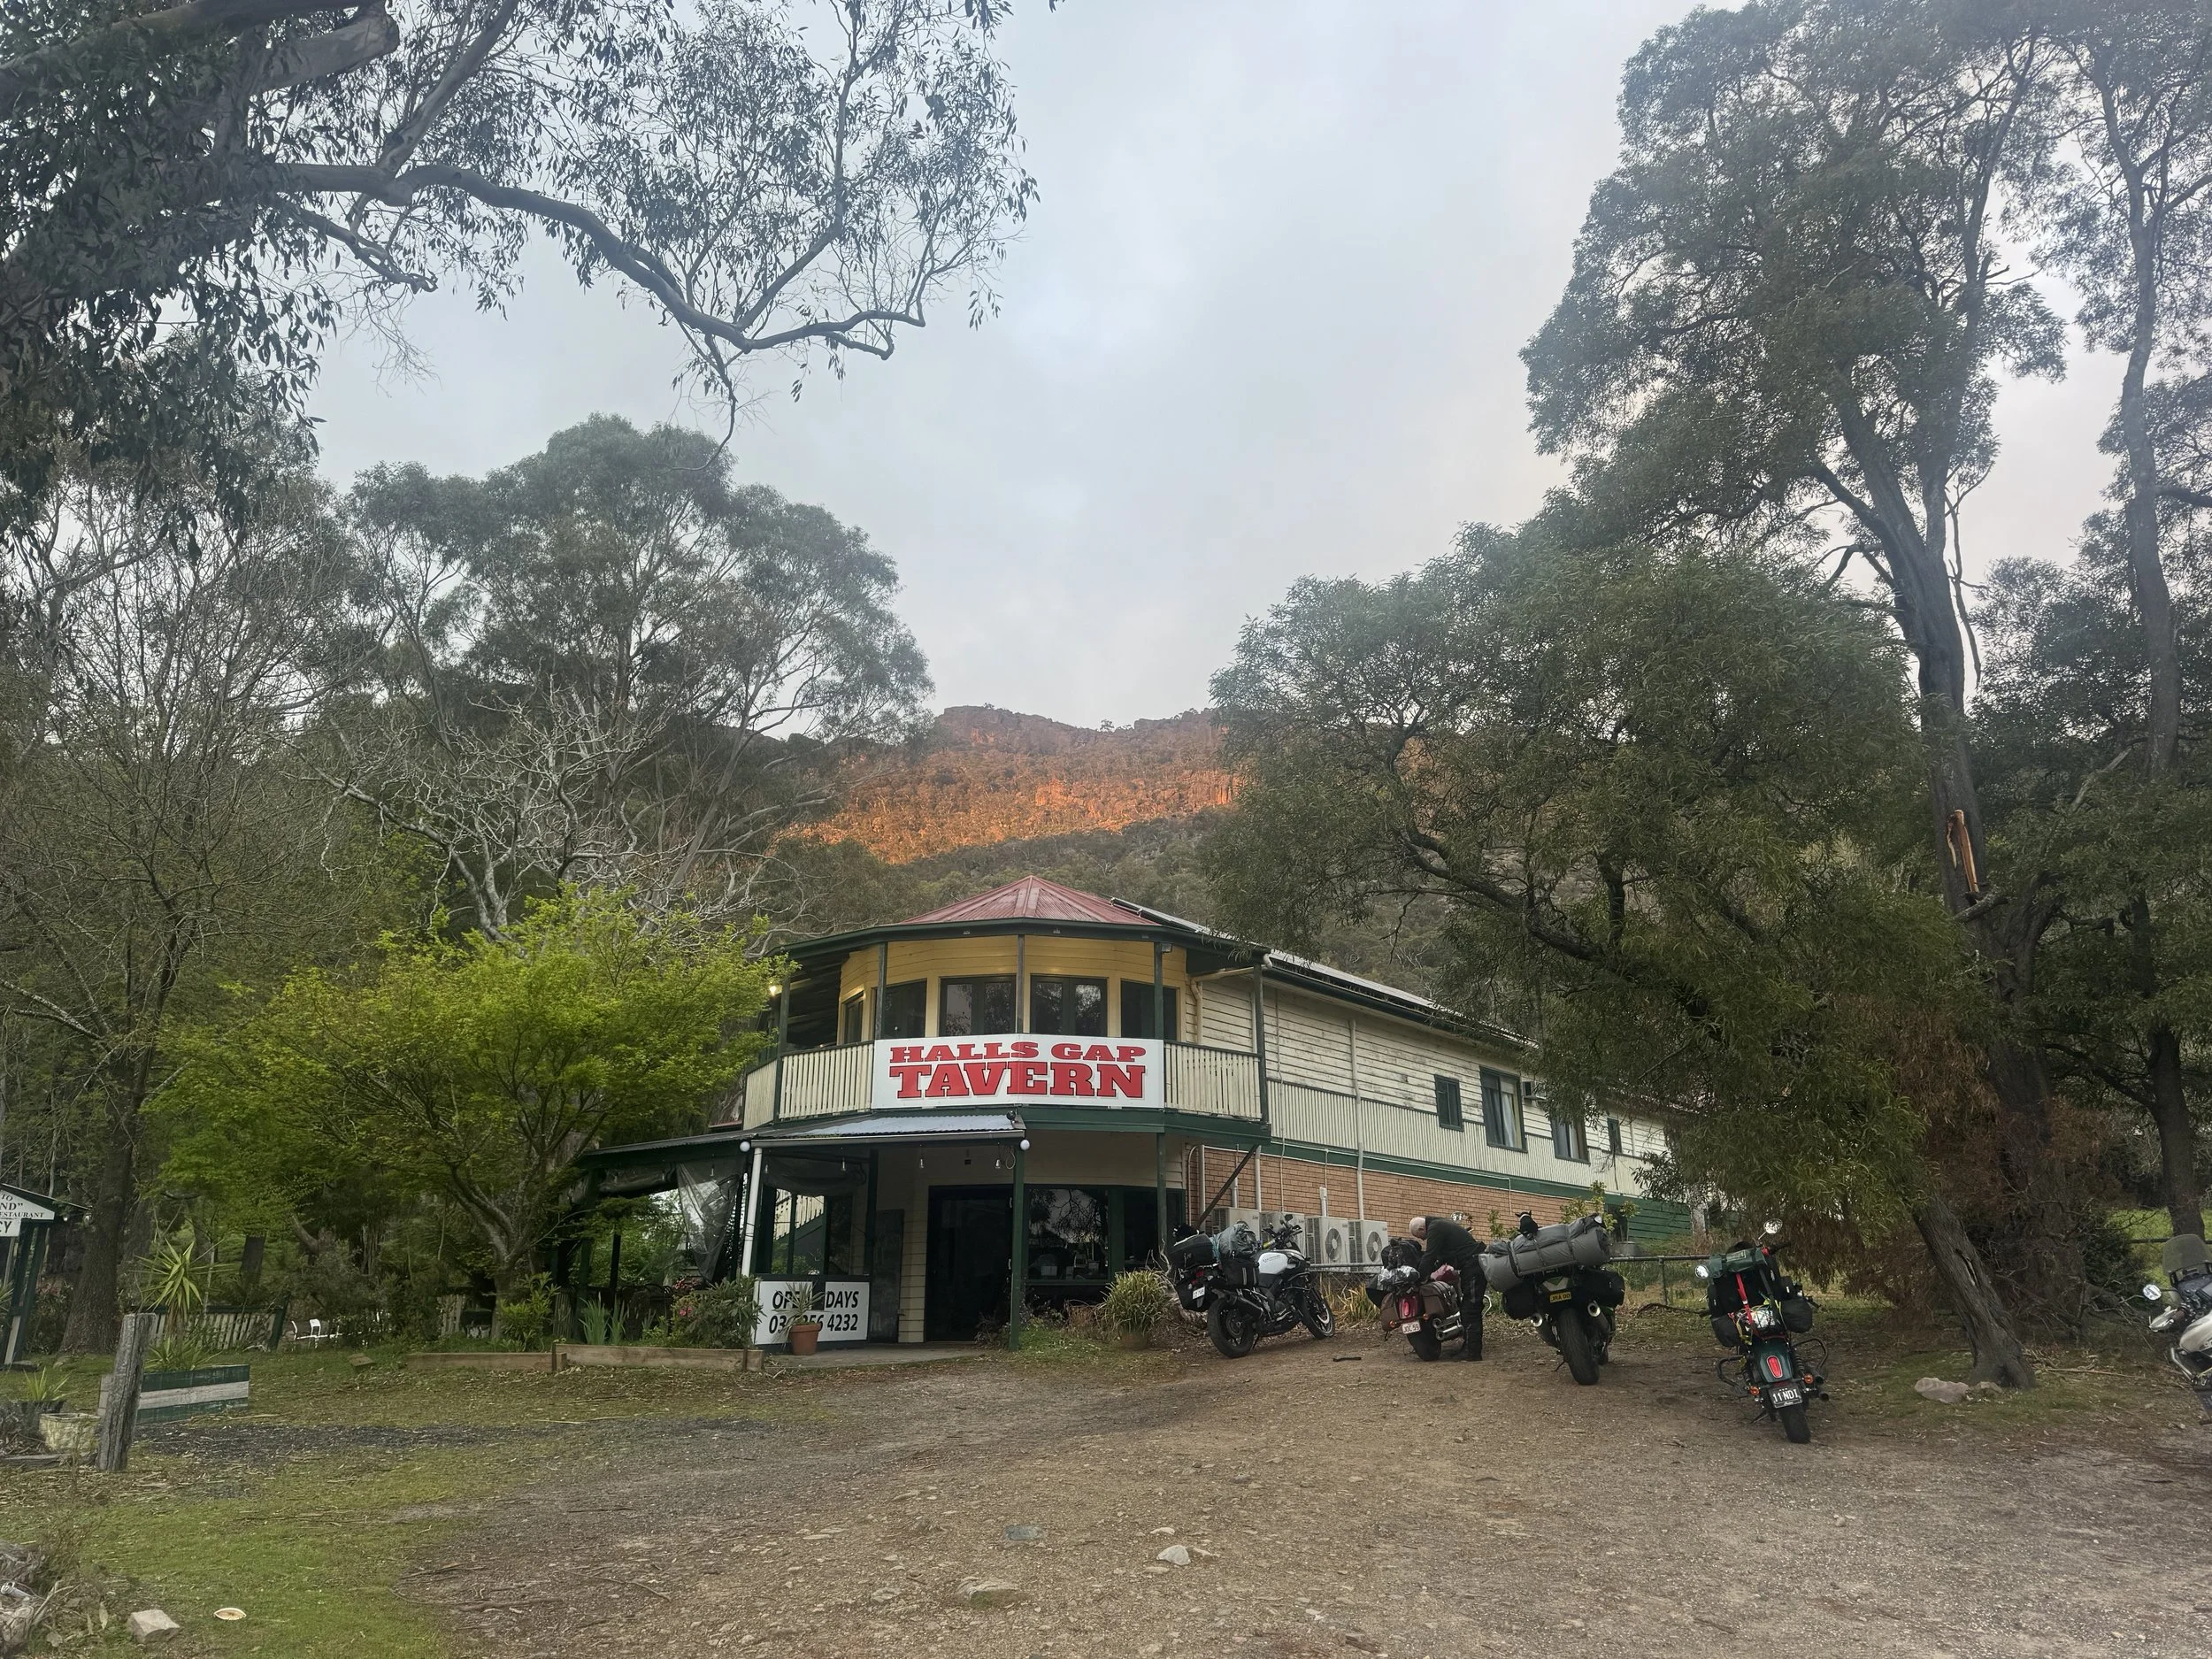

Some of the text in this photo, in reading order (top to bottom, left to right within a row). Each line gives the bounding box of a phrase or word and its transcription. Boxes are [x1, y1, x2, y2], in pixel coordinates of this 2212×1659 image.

[889, 1041, 1147, 1063] HALLS GAP
[889, 1061, 1147, 1099] TAVERN
[772, 1291, 859, 1310] OPE DAYS
[769, 1315, 787, 1334] 03
[827, 1313, 858, 1332] 4232
